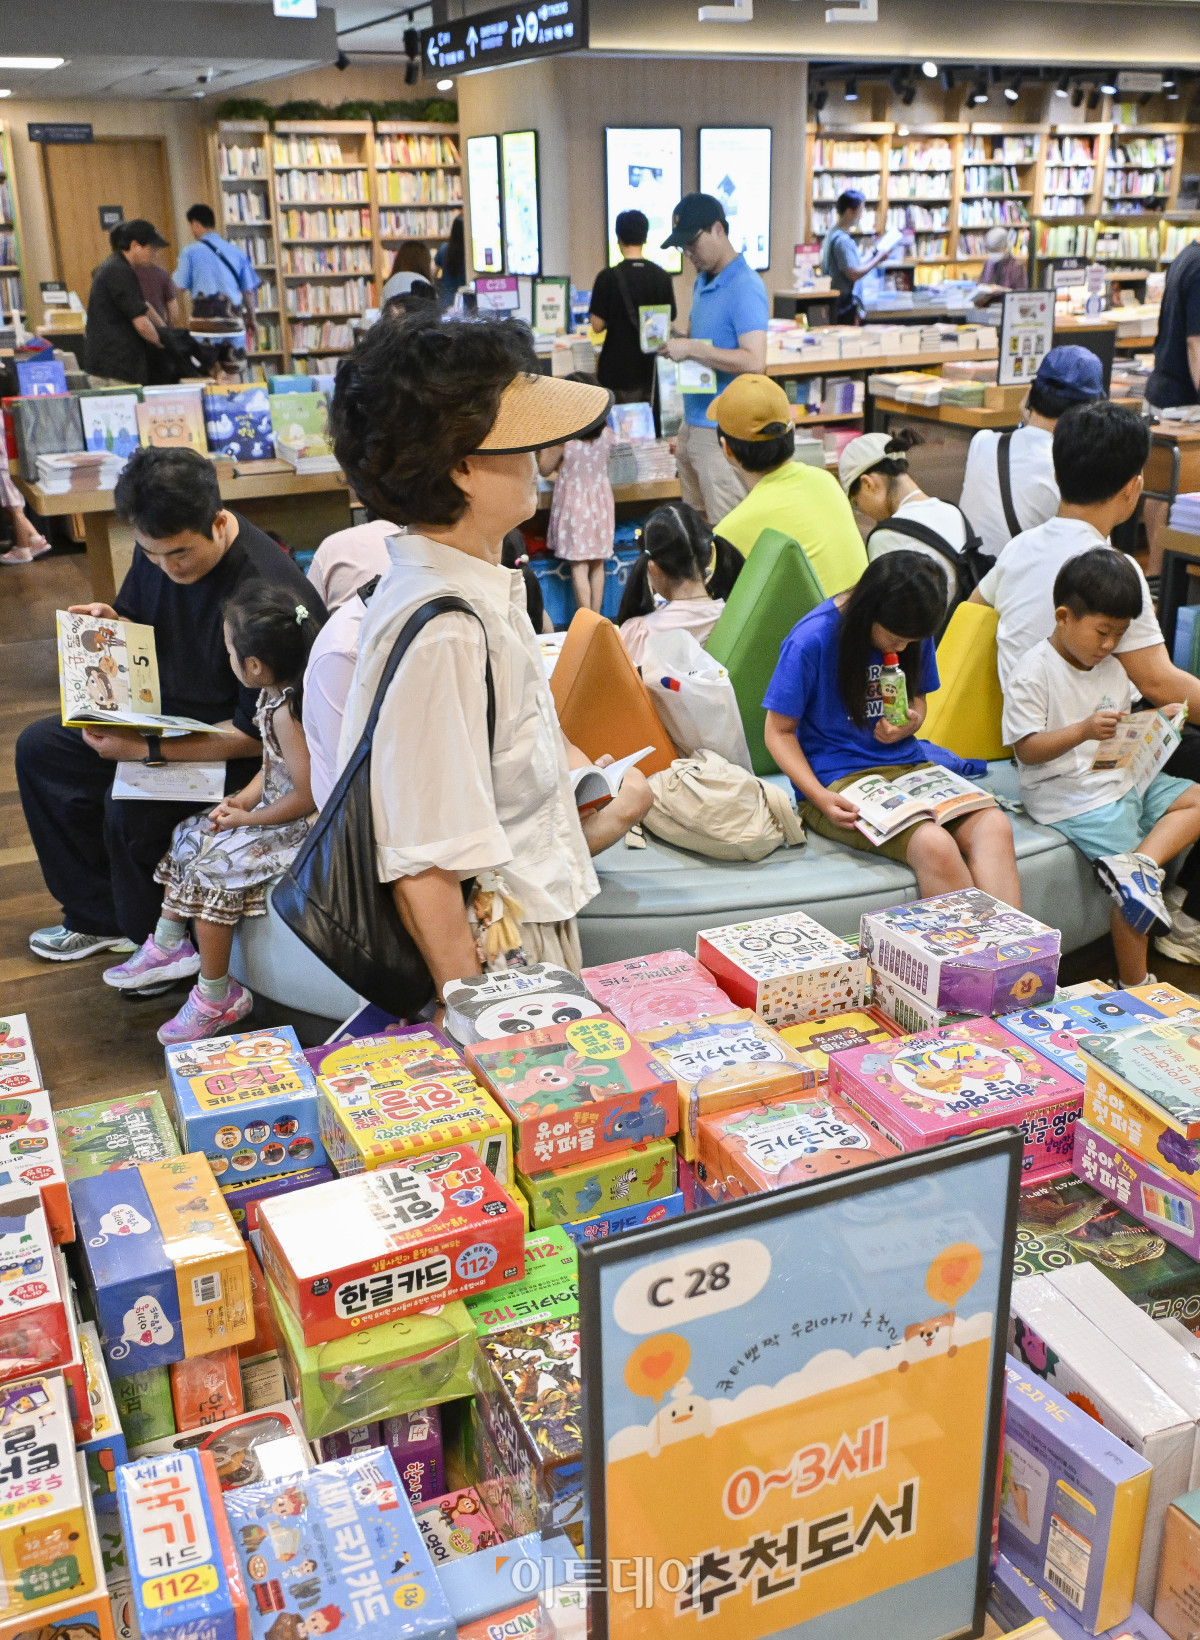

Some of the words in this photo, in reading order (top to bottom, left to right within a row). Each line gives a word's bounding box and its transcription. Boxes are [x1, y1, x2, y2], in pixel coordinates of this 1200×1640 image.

[739, 927, 818, 951] 100
[480, 982, 512, 995] 카드
[513, 976, 543, 992] 사물
[598, 976, 630, 987] 카드
[674, 1037, 767, 1067] 한자카드
[1132, 1045, 1192, 1085] 미안하다고
[205, 1066, 285, 1095] 120
[206, 1095, 235, 1106] 카드
[369, 1081, 466, 1121] 한글
[1095, 1081, 1126, 1112] 유아
[373, 1120, 430, 1141] 생생한
[537, 1121, 572, 1142] 유아
[750, 1118, 851, 1157] 한글카드
[1091, 1101, 1110, 1126] 첫
[1110, 1110, 1144, 1148] 퍼즐
[534, 1138, 555, 1162] 첫
[556, 1127, 597, 1154] 퍼즐
[1084, 1138, 1116, 1169] 유아
[1081, 1155, 1099, 1183] 첫
[1099, 1170, 1133, 1206] 퍼즐
[611, 1215, 637, 1232] 카드
[371, 1254, 411, 1272] 실물사진과
[412, 1247, 440, 1260] 문장으로
[441, 1240, 461, 1251] 배우는
[338, 1259, 448, 1315] 한글카드
[648, 1277, 675, 1308] C
[684, 1262, 731, 1301] 28
[790, 1312, 854, 1339] 우리아기
[134, 1457, 184, 1482] 세계
[726, 1417, 888, 1517] 0~3세
[136, 1476, 197, 1544] 국기
[149, 1546, 202, 1568] 카드
[680, 1482, 915, 1615] 추천도서
[153, 1572, 203, 1600] 112
